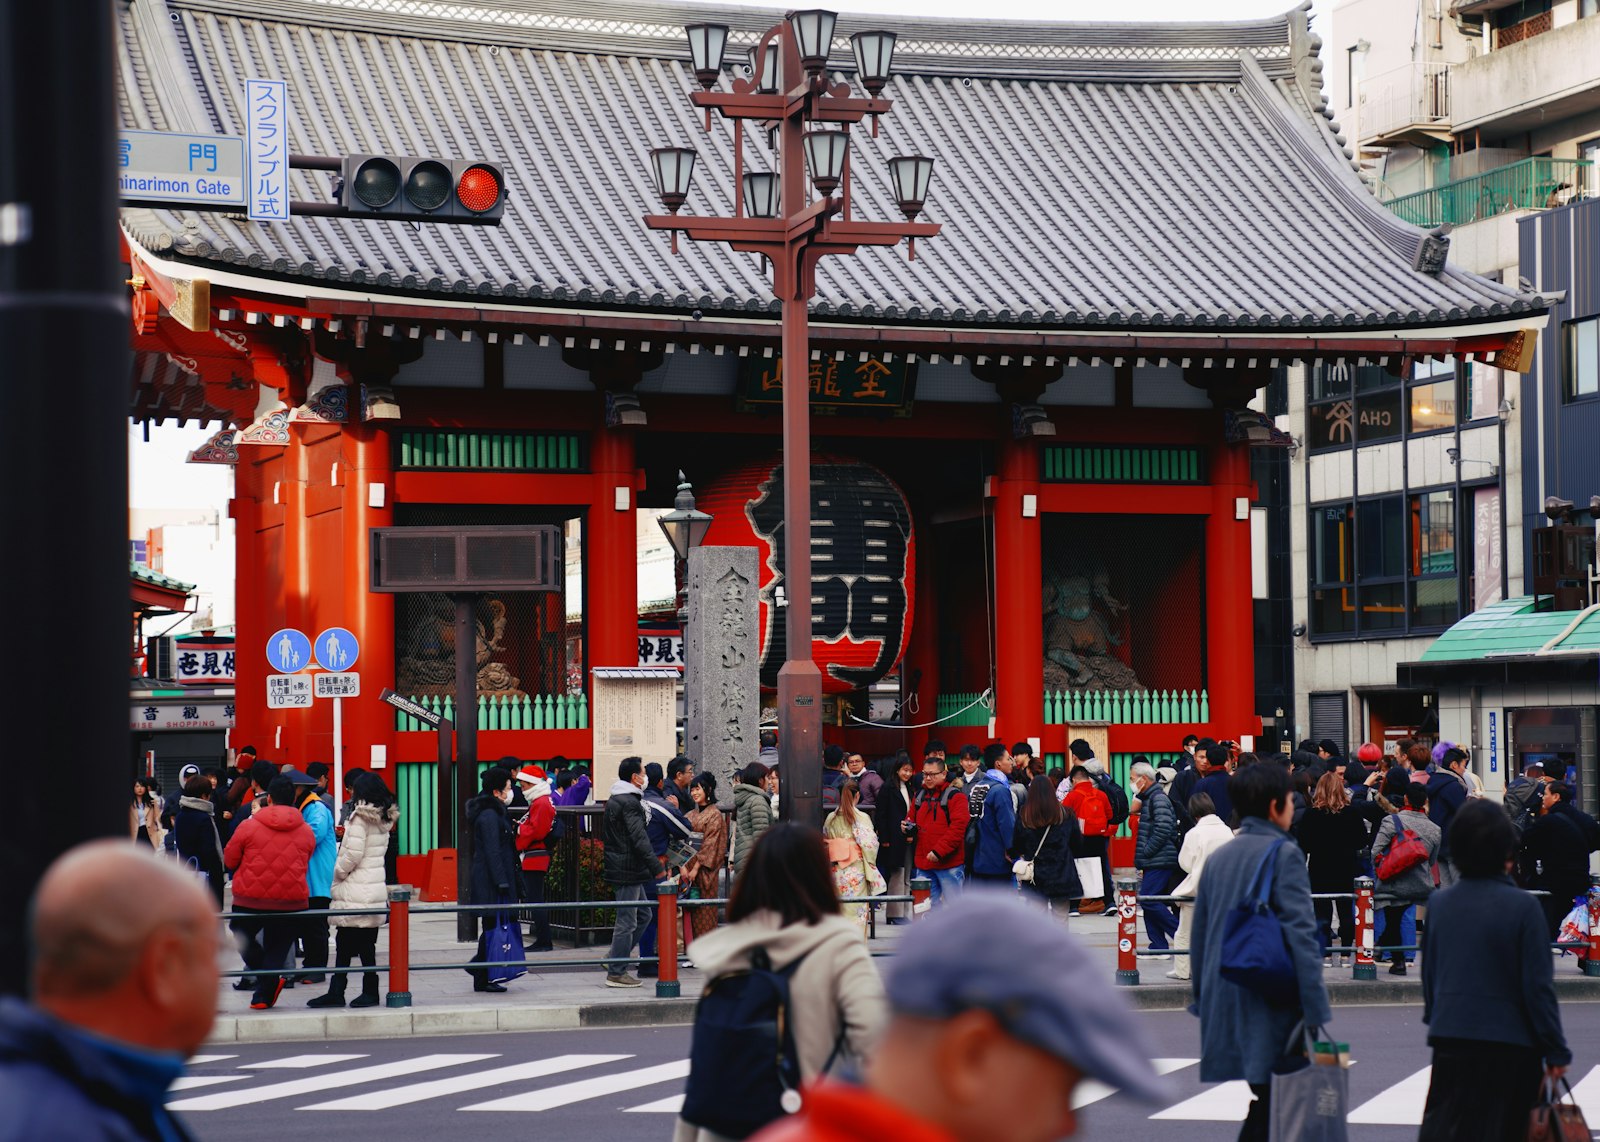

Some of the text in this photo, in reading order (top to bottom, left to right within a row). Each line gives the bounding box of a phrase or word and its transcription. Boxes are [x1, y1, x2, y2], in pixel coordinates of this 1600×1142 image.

[258, 86, 279, 214] スクランブル式
[197, 179, 231, 194] Gate
[270, 678, 290, 687] 自転車
[270, 686, 290, 695] 人力車
[318, 685, 356, 694] 仲見世通り
